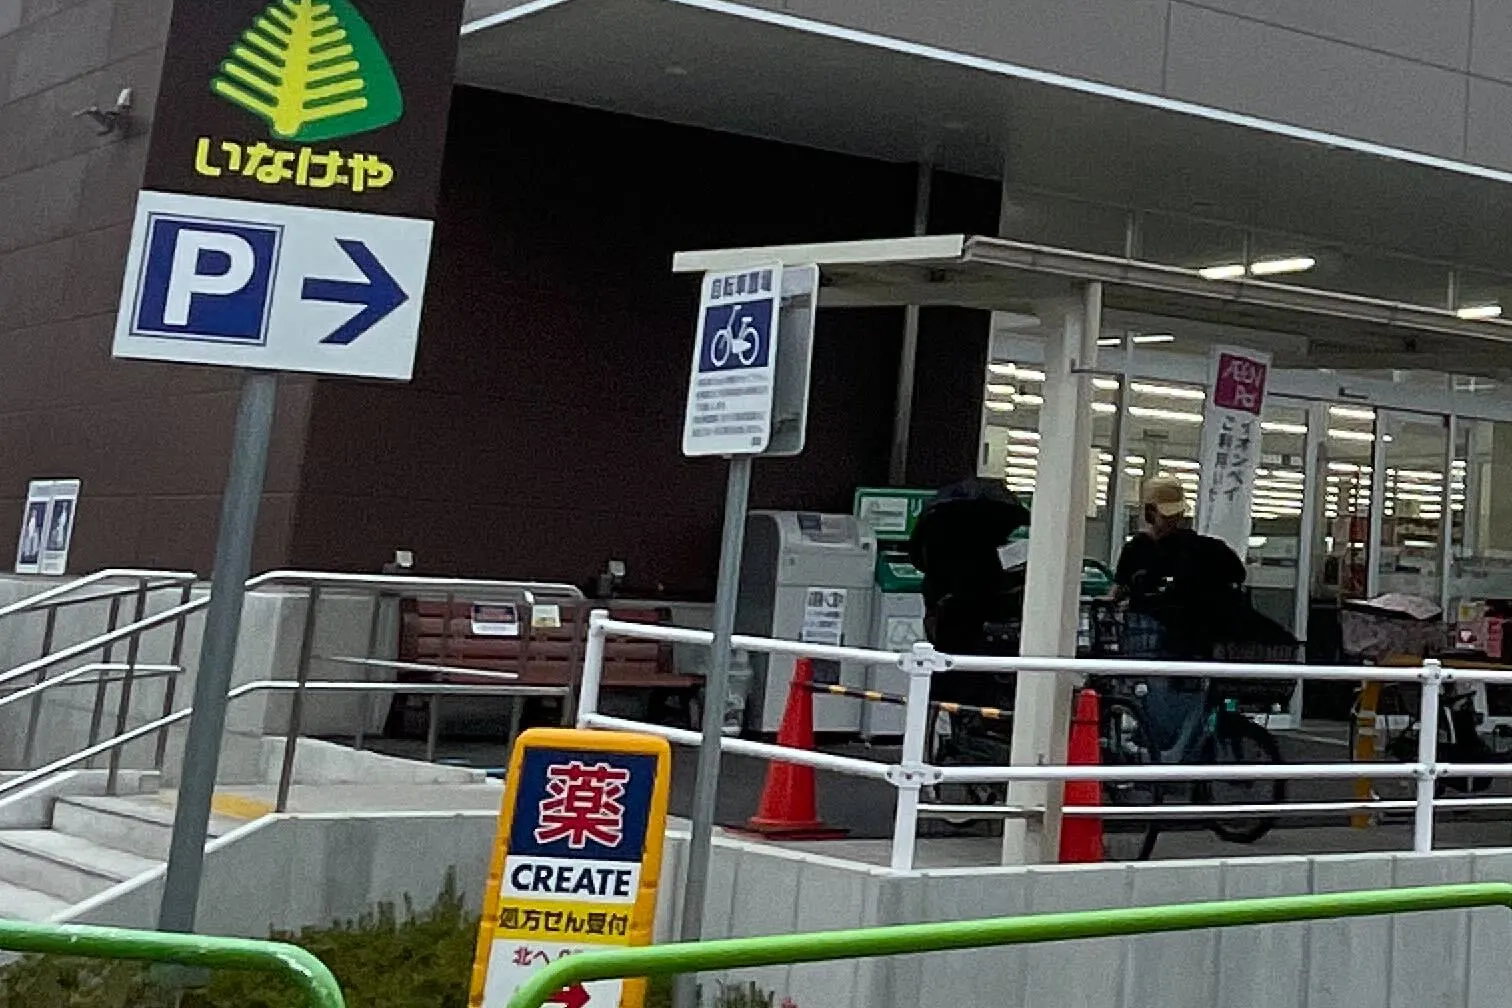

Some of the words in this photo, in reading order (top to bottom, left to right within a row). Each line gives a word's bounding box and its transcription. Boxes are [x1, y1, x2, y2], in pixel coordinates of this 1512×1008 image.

[195, 137, 394, 192] いなげや
[162, 228, 256, 327] P
[534, 761, 630, 849] 薬
[511, 863, 632, 897] CREATE
[498, 907, 629, 936] 処方せん受付
